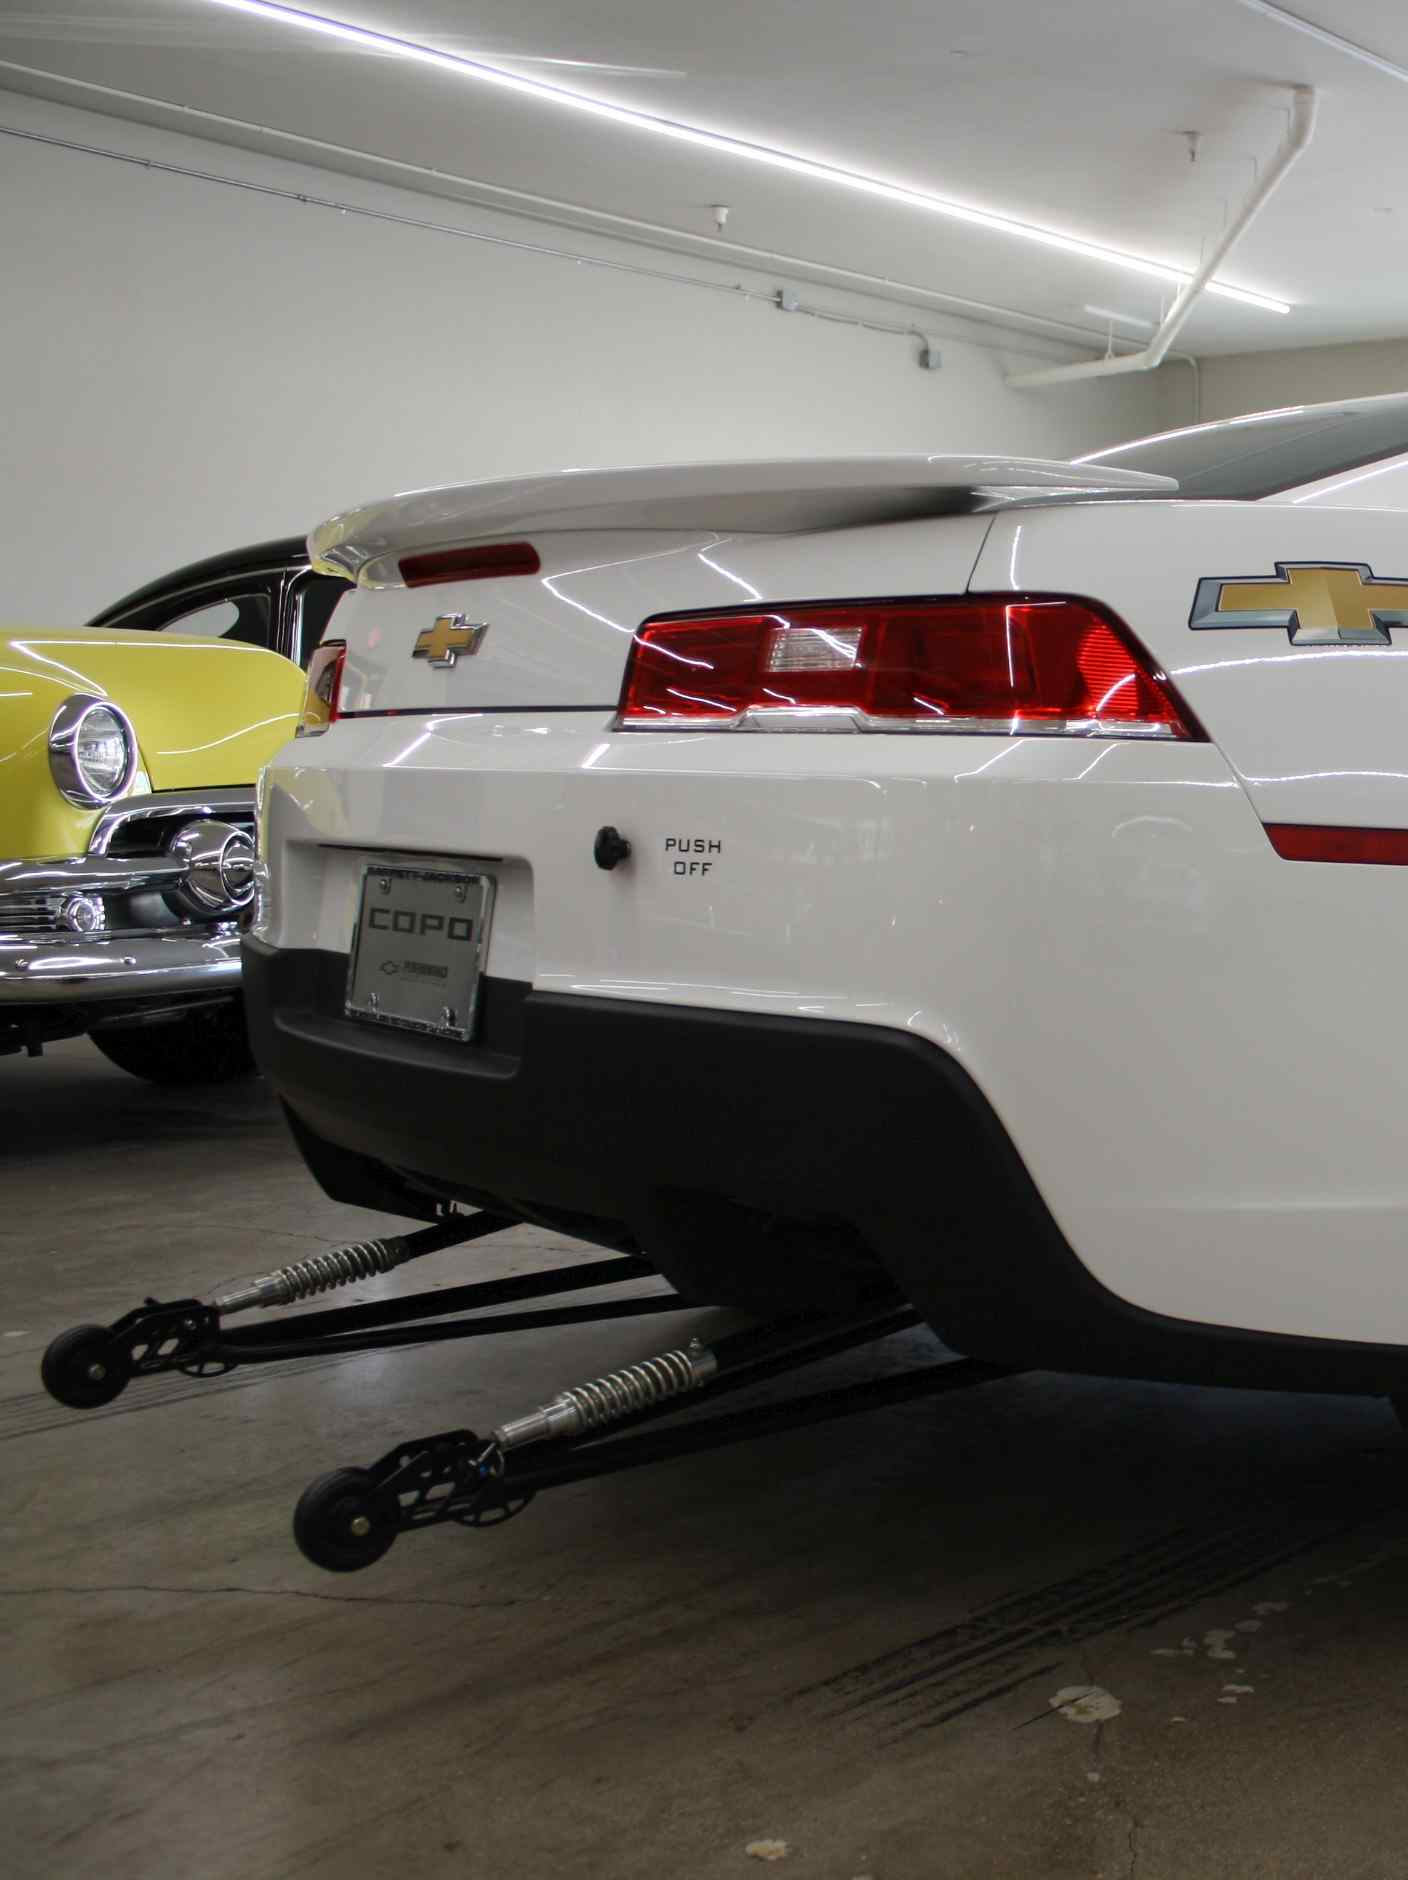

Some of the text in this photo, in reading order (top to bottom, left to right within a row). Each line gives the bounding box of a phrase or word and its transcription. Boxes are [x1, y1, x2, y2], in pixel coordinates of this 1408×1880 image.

[665, 838, 722, 854] PUSH
[673, 861, 713, 876] OFF
[369, 906, 474, 941] COPO
